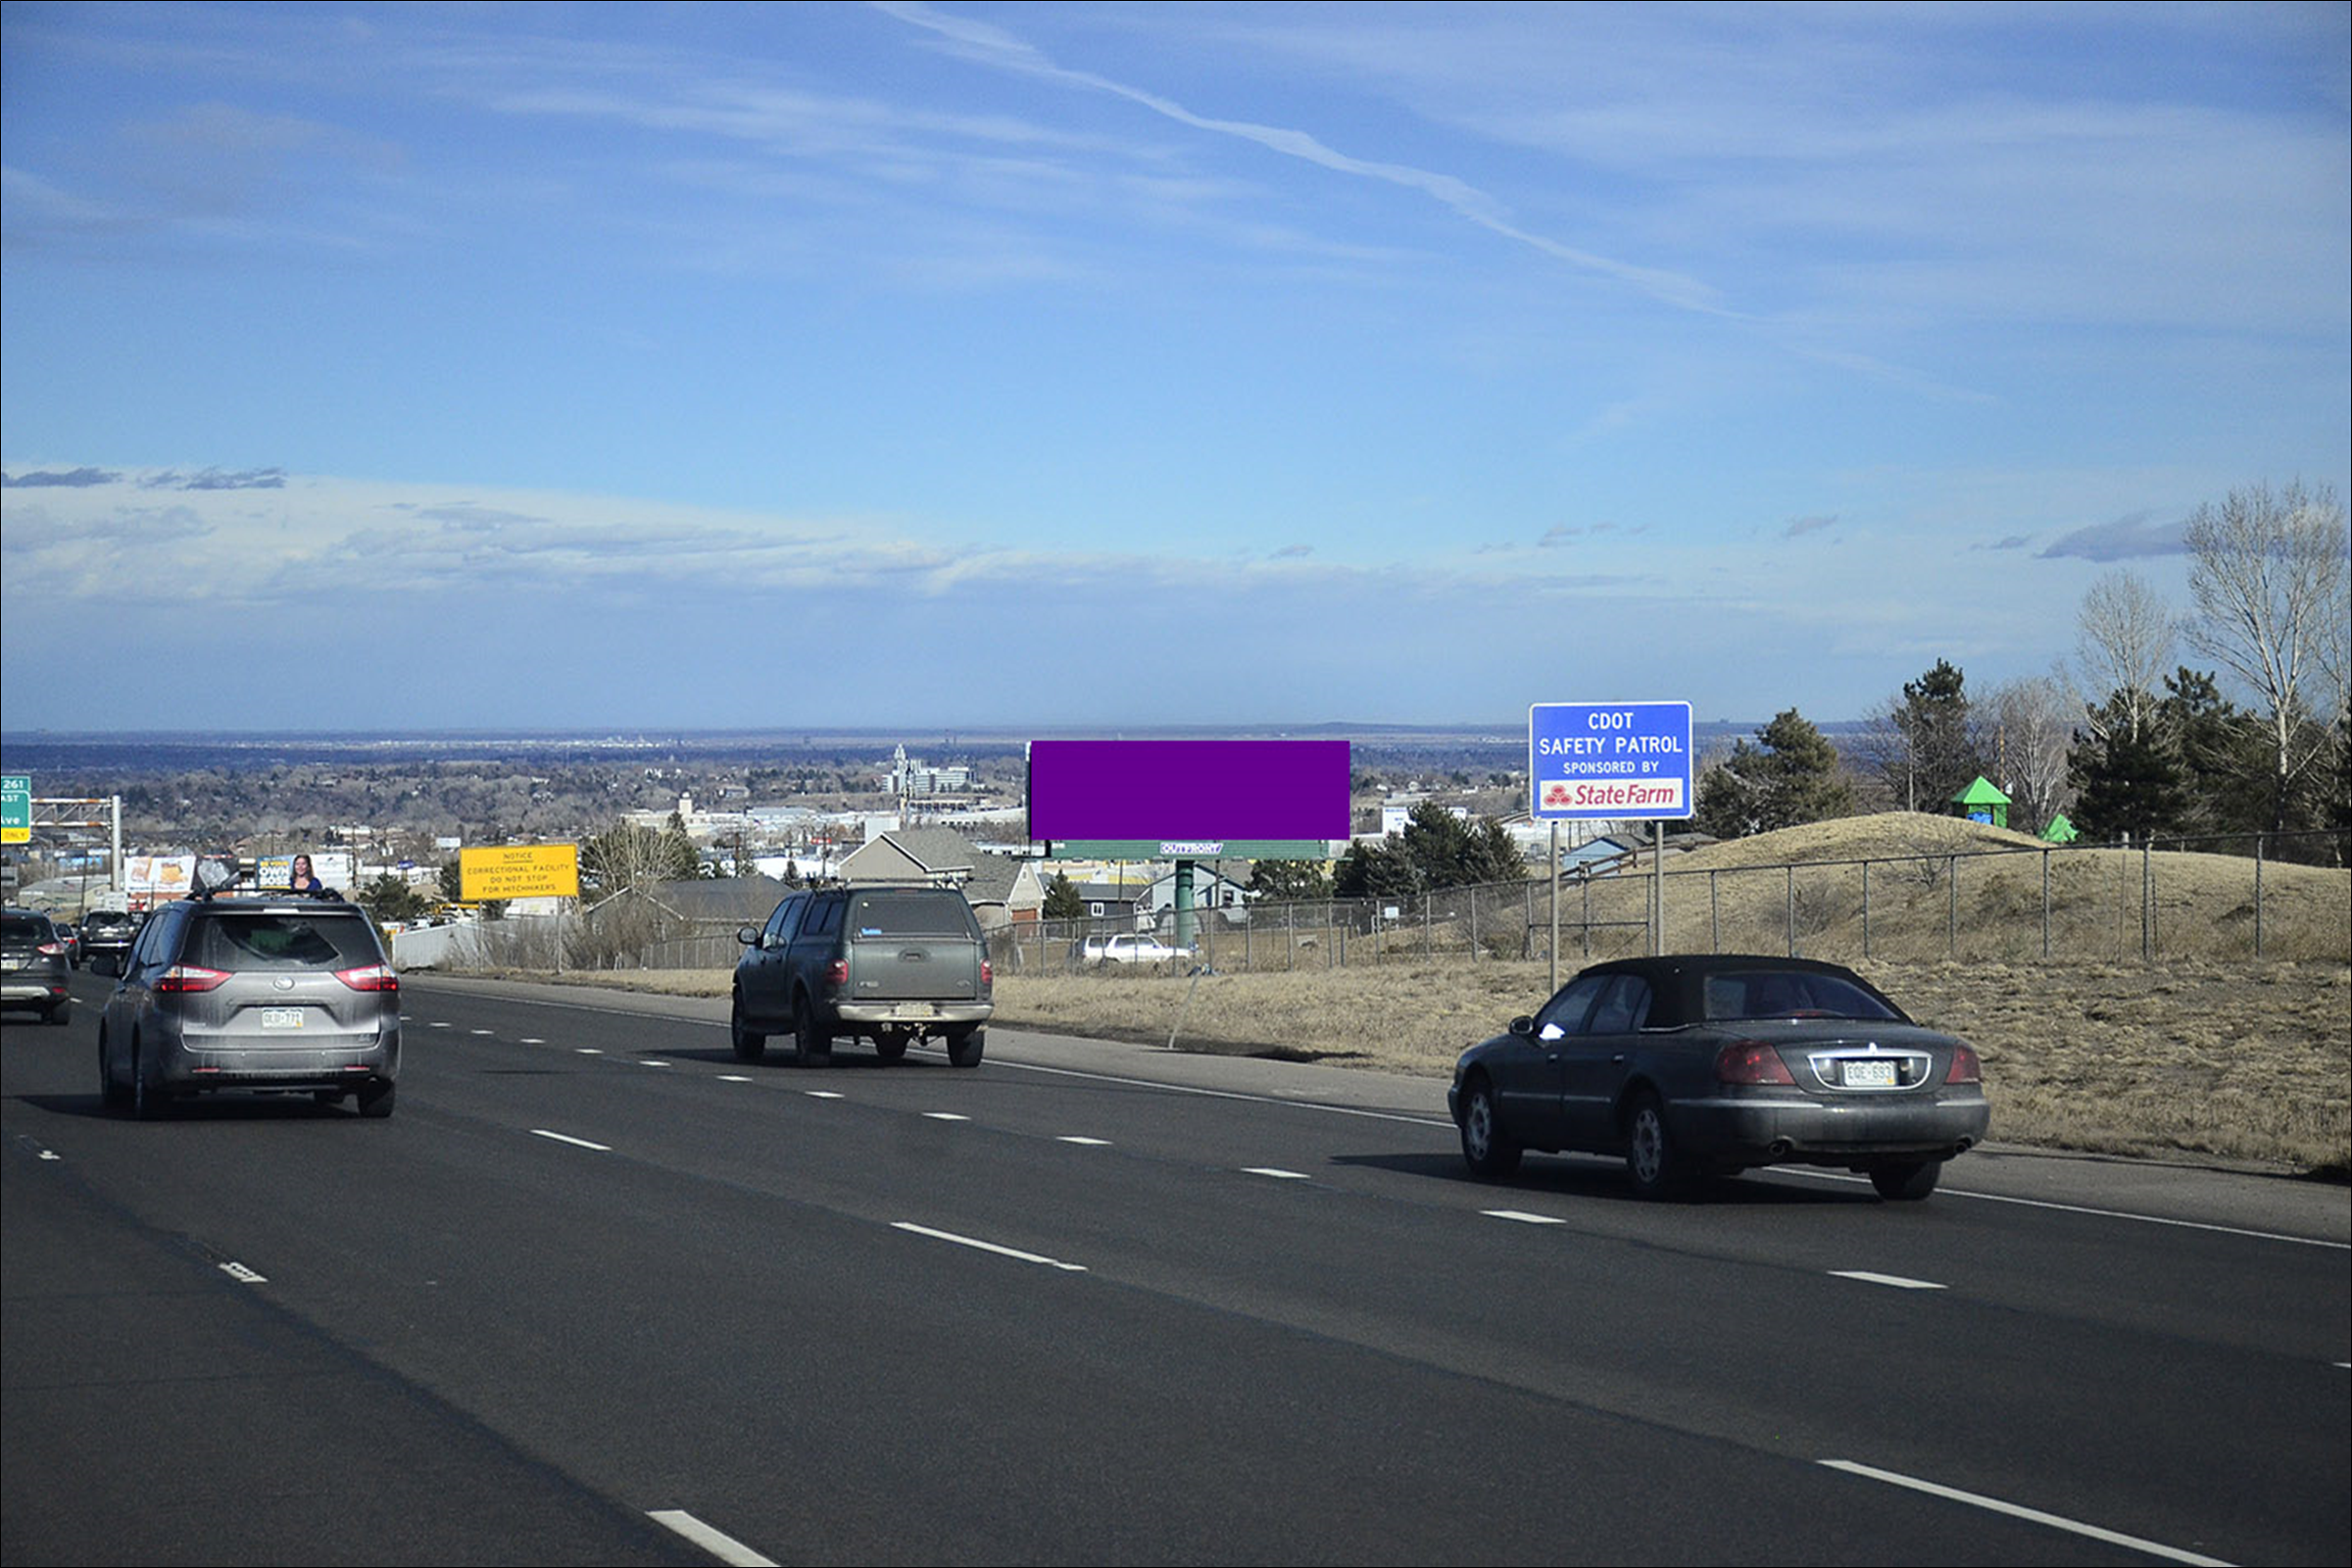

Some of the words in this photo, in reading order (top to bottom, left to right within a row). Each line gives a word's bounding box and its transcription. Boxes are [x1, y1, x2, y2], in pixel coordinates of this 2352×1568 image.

[1588, 712, 1634, 729] CDOT
[1540, 737, 1606, 755] SAFETY
[1616, 736, 1683, 754] PATROL
[1563, 761, 1636, 774] SPONSORED
[1642, 760, 1659, 773] BY
[3, 779, 24, 789] 261
[259, 866, 291, 877] OWN
[503, 883, 557, 893] HITCHHIKERS
